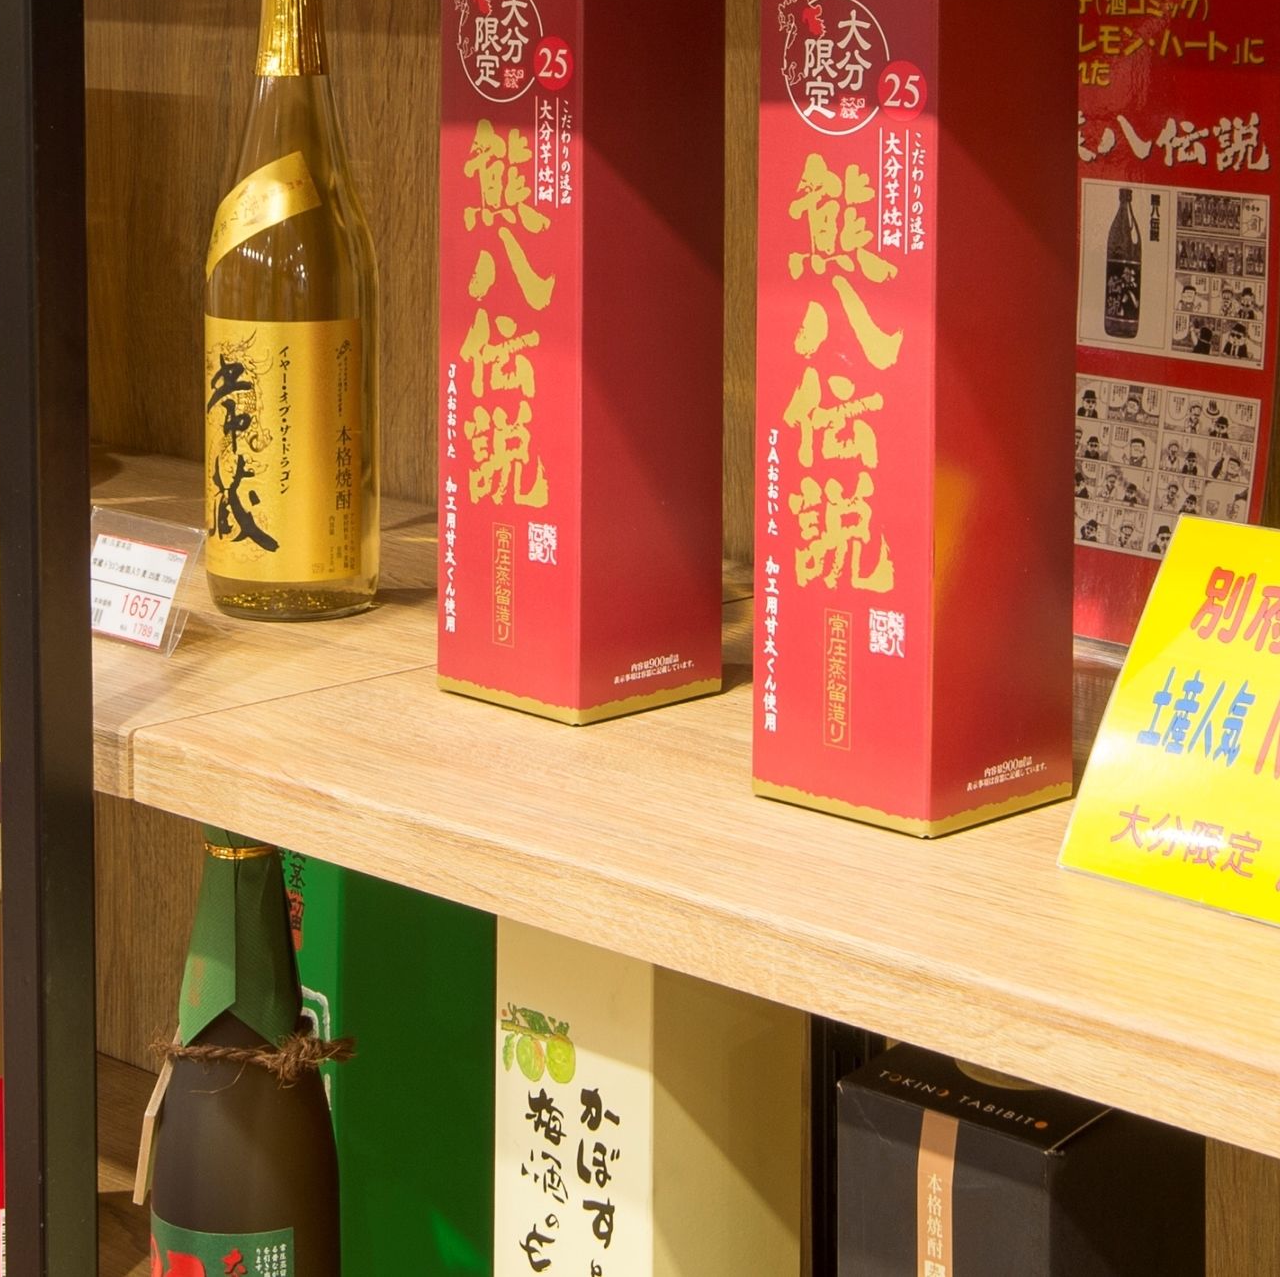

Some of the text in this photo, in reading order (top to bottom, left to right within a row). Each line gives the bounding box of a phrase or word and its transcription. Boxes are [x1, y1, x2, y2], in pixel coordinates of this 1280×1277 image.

[474, 17, 501, 89] 限定
[538, 48, 569, 80] 25
[803, 38, 836, 121] 限定
[836, 9, 873, 92] 大分
[883, 73, 921, 110] 25
[538, 99, 554, 203] 大分芋焼酎
[560, 99, 572, 205] こだわりの逸品
[1078, 111, 1271, 172] 八伝説
[882, 132, 904, 249] 大分芋焼酎
[909, 132, 927, 252] こだわりの逸品
[460, 118, 556, 508] 熊八伝説
[783, 153, 904, 594] 熊八伝説
[335, 425, 353, 511] 本格焼酎
[444, 363, 457, 634] JAおおいた 加工用甘太くん使用
[121, 592, 161, 622] 1657
[494, 526, 512, 643] 常圧蒸留造り
[763, 428, 781, 733] JAおおいた 加工用甘太くん使用
[827, 613, 849, 746] 常圧蒸留造り
[1135, 665, 1257, 768] 土産人気
[1109, 803, 1264, 880] 大分限定
[879, 1068, 1049, 1131] TOKINO TABIBITO
[926, 1172, 945, 1260] 本格焼酎
